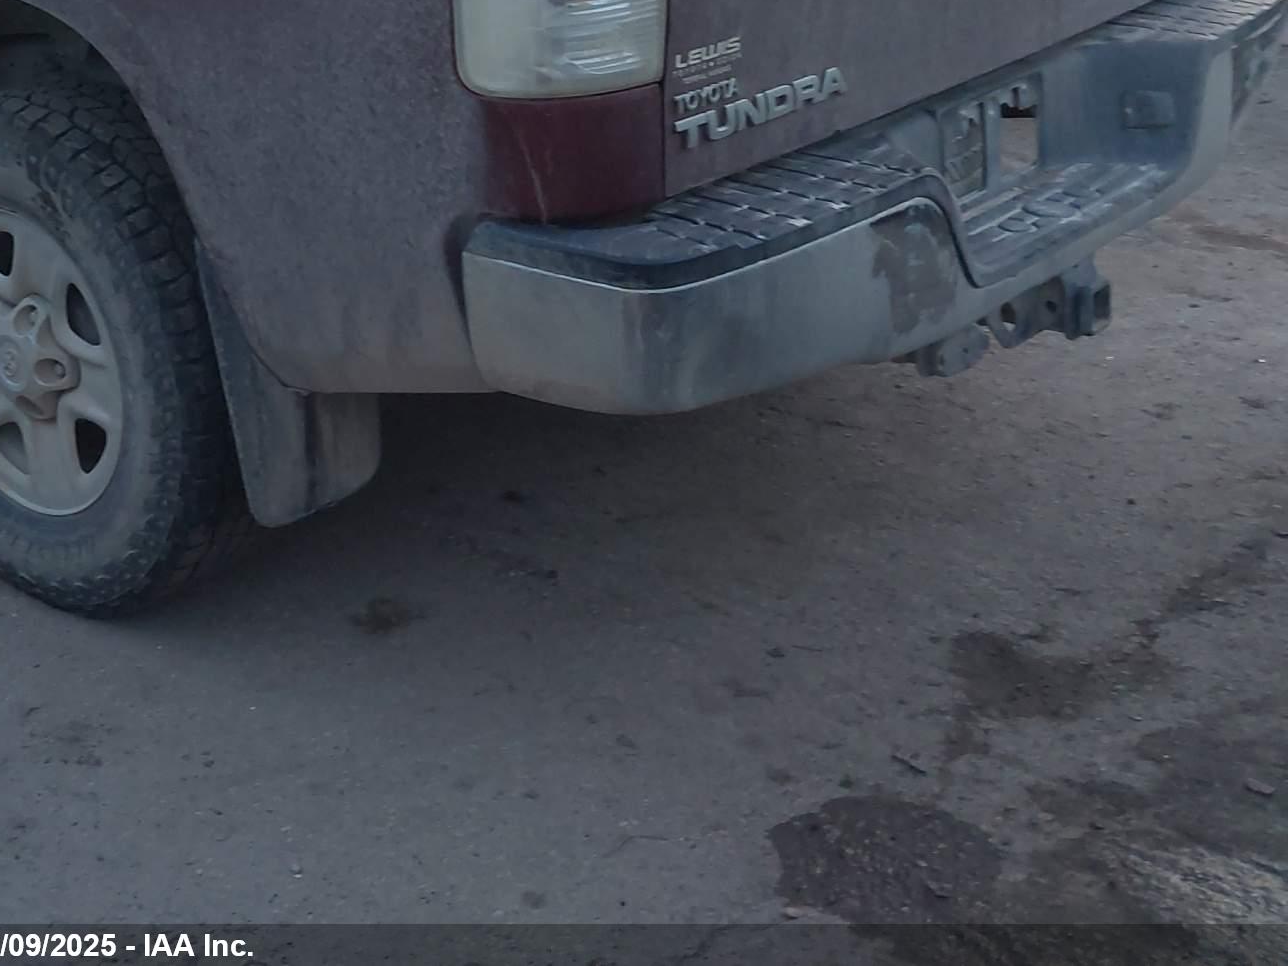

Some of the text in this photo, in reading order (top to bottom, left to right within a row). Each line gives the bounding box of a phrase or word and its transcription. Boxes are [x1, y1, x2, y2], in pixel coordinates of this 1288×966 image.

[674, 36, 742, 68] LEWIS
[673, 77, 740, 114] TOYOTA
[673, 66, 848, 149] TUNDRA
